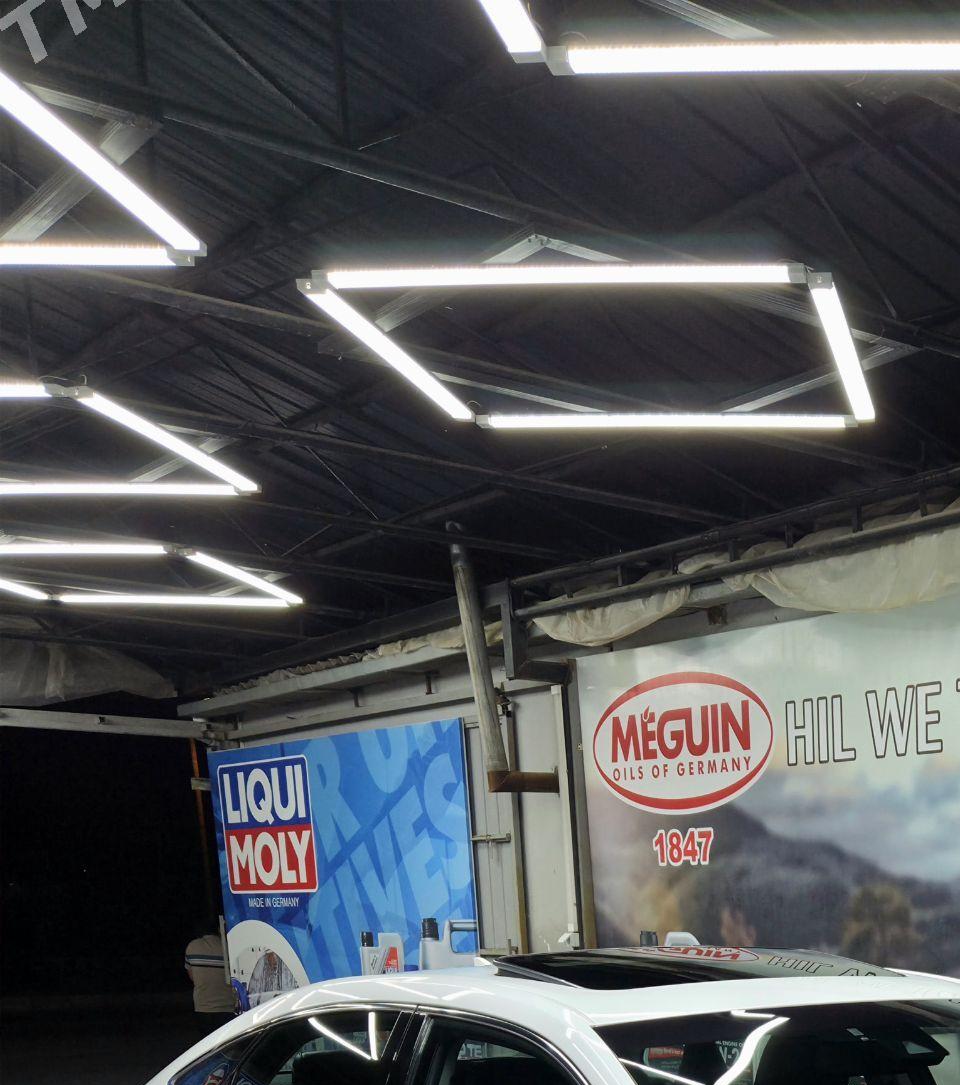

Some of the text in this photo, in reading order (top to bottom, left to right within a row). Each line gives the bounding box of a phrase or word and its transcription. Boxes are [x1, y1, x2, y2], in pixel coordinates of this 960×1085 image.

[785, 694, 857, 767] HIL
[866, 680, 943, 759] WE
[613, 756, 751, 781] OILS OF GERMANY
[223, 764, 306, 825] LIQUI
[229, 829, 311, 886] MOLY
[653, 827, 714, 866] 1847
[248, 897, 299, 908] MADE IN GERMANY
